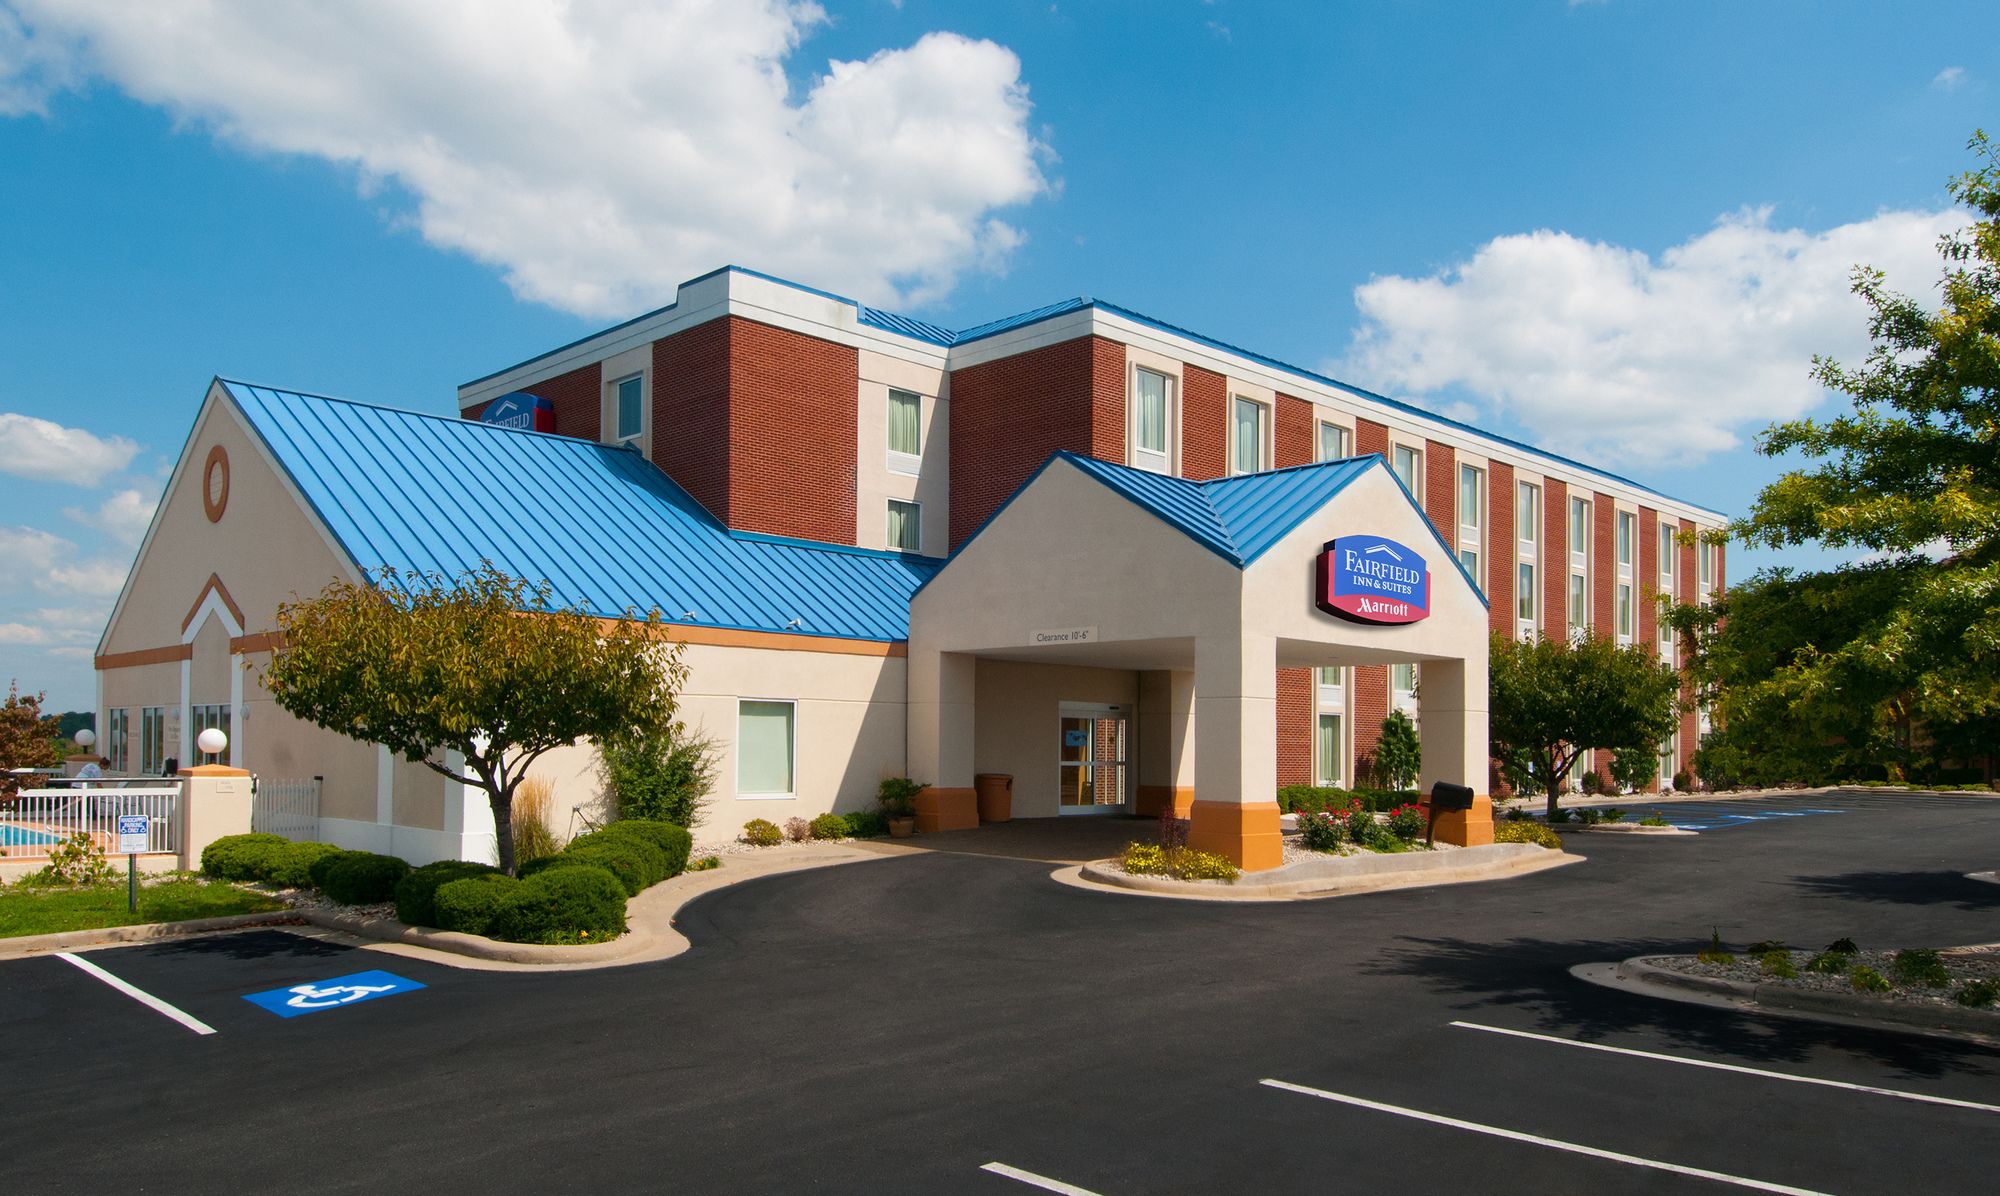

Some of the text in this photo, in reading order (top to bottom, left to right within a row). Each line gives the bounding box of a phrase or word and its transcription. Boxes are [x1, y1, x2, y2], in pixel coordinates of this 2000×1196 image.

[1345, 549, 1420, 585] FAIRFIELD
[1353, 575, 1412, 595] INN & SUITES
[1356, 597, 1409, 617] Marriott
[1036, 632, 1069, 642] Clearance
